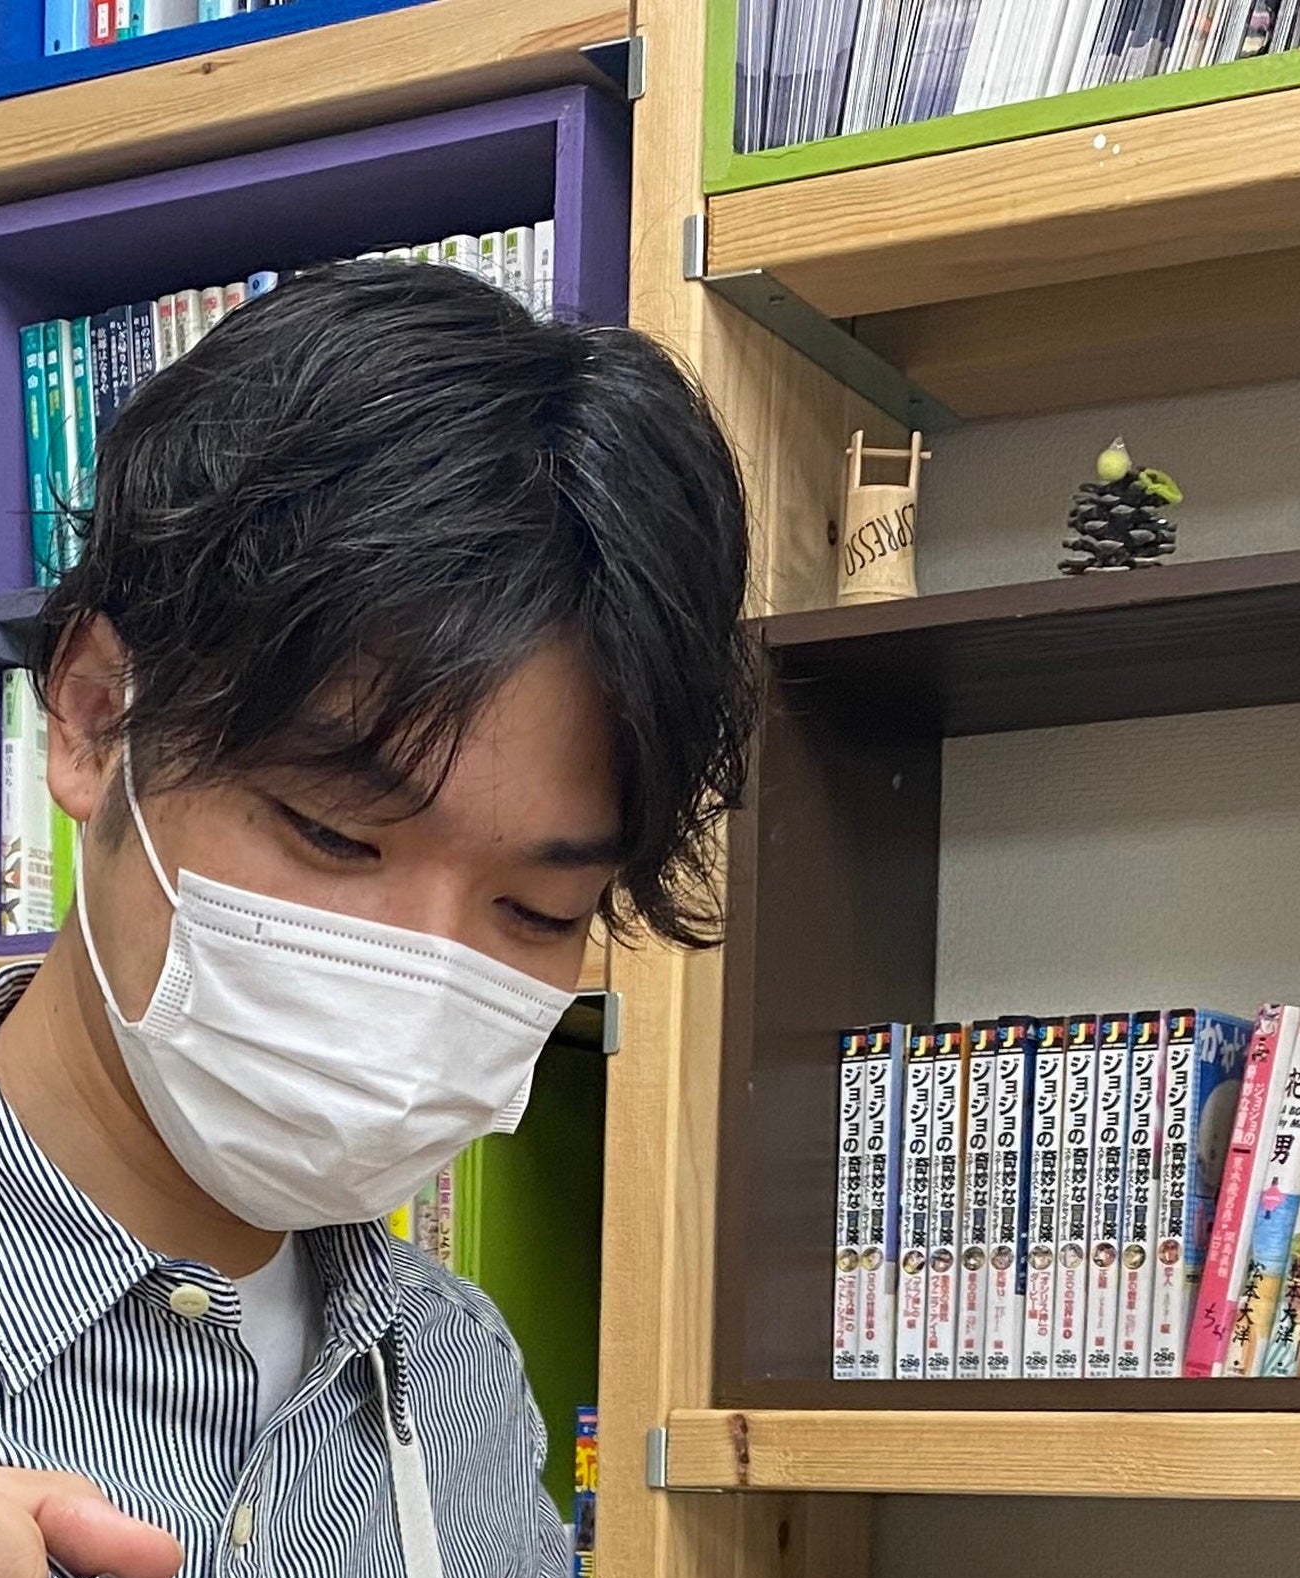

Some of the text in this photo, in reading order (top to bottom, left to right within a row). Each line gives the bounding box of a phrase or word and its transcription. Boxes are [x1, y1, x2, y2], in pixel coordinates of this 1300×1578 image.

[843, 1066, 862, 1246] ジョジョの奇妙な冒険
[868, 1064, 887, 1245] ジョジョの奇妙な冒険
[910, 1068, 931, 1248] ジョジョの奇妙な冒険
[936, 1065, 957, 1246] ジョジョの奇妙な冒険
[970, 1062, 991, 1245] ジョジョの奇妙な冒険
[998, 1059, 1019, 1244] ジョジョの奇妙な冒険
[1037, 1058, 1059, 1243] ジョジョの奇妙な冒険
[1068, 1055, 1091, 1242] ジョジョの奇妙な冒険
[1101, 1054, 1123, 1241] ジョジョの奇妙な冒険
[1132, 1055, 1154, 1243] ジョジョの奇妙な冒険
[1167, 1048, 1190, 1238] ジョジョの奇妙な冒険
[1243, 1082, 1265, 1146] ジョジョの
[1271, 1133, 1295, 1165] 男
[1233, 1258, 1266, 1347] 松本大洋
